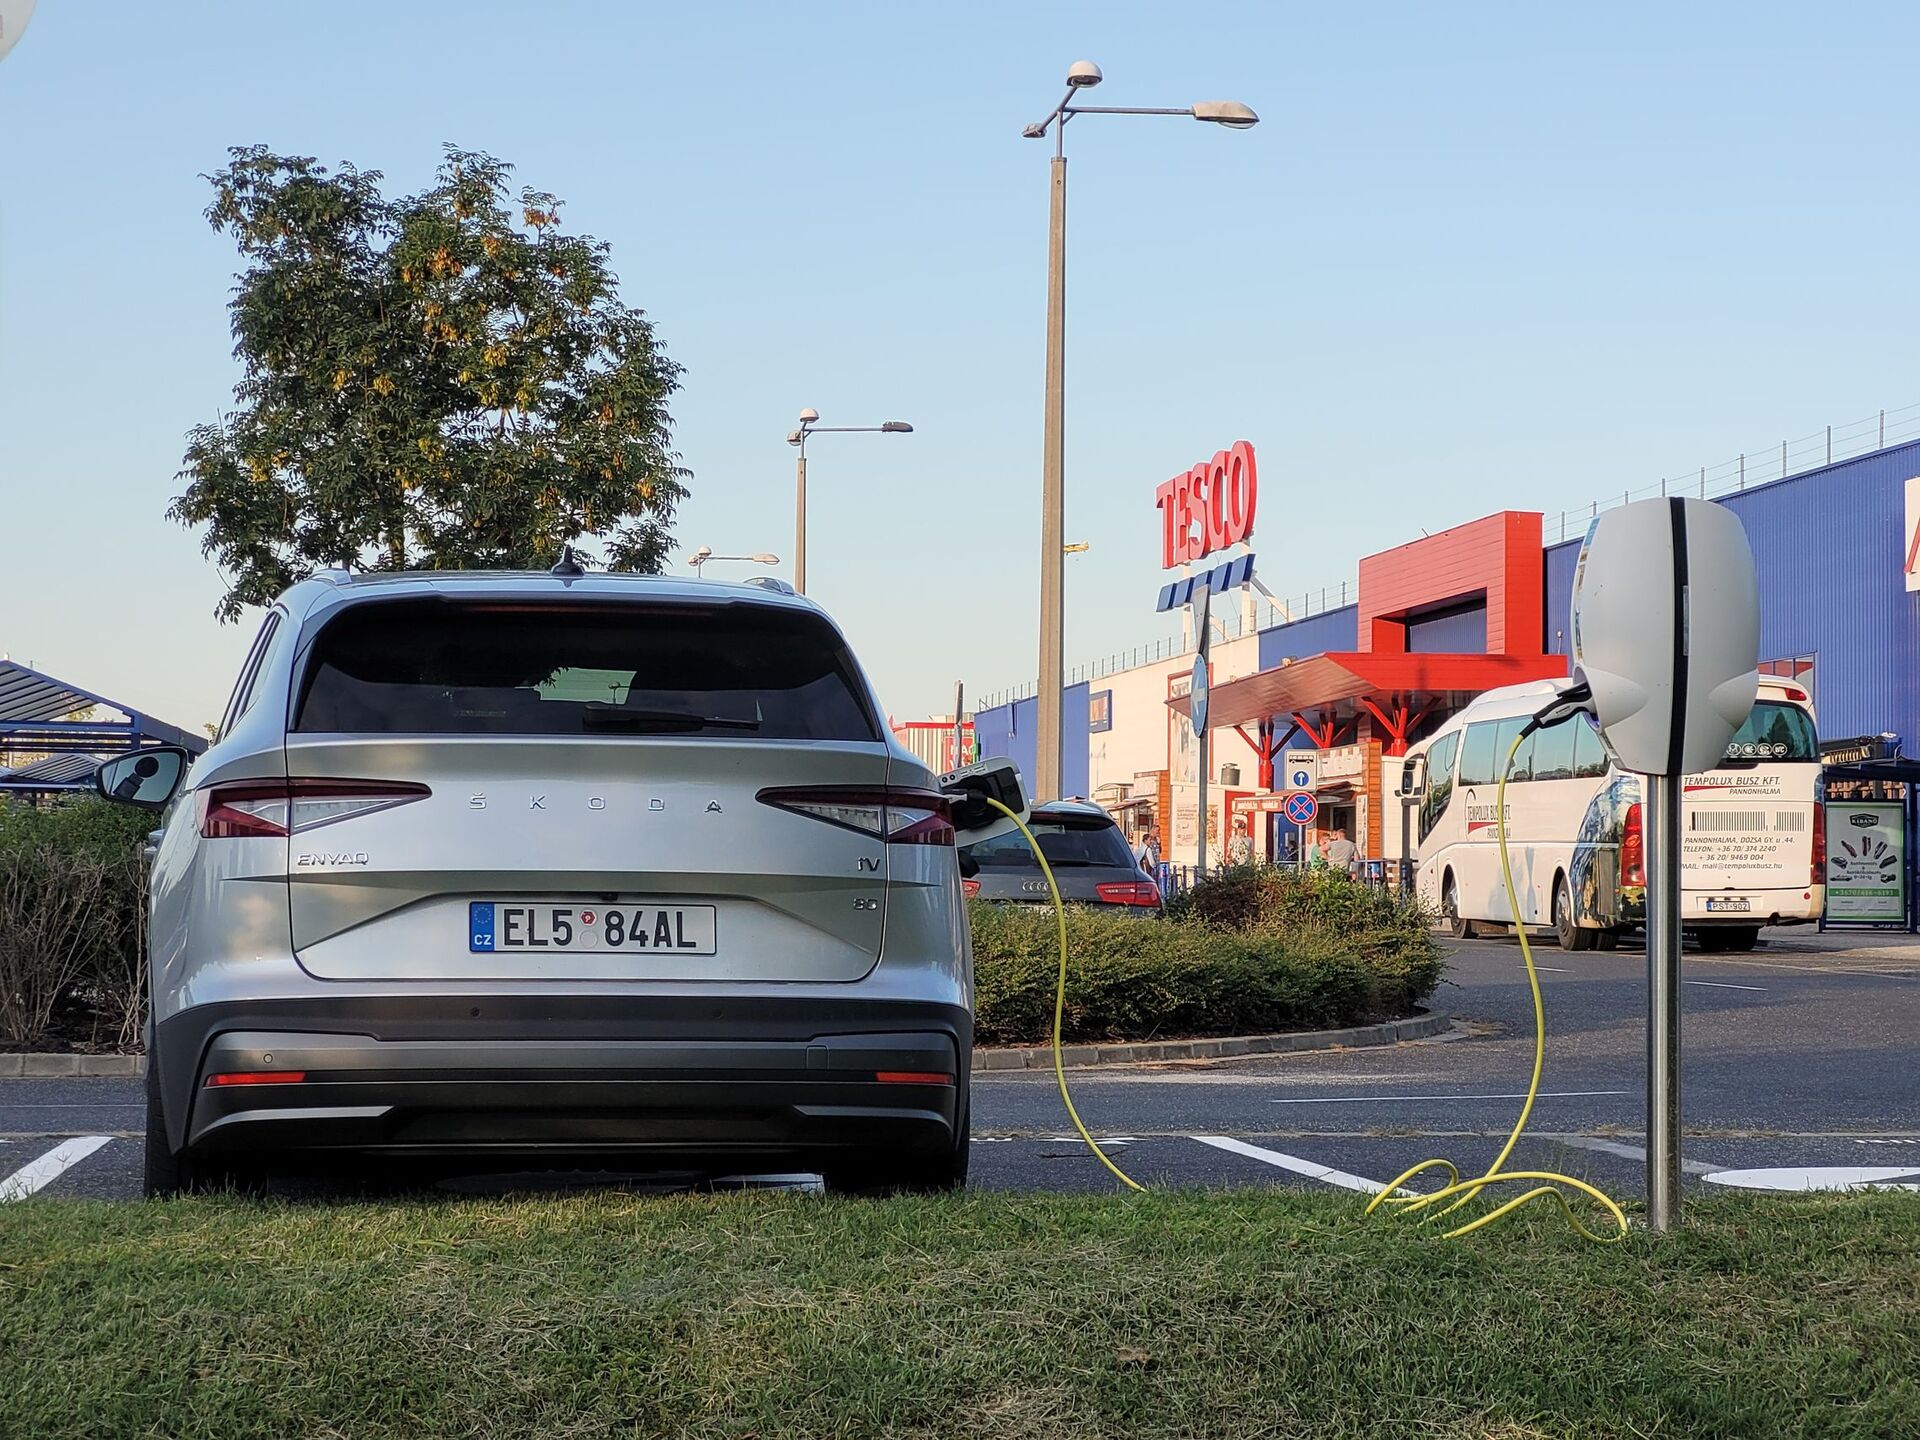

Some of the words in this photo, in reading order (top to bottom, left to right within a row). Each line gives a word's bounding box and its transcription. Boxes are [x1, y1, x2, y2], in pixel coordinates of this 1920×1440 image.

[1156, 440, 1257, 569] TESCO
[1684, 777, 1732, 785] TEMPOLUX
[1736, 777, 1760, 785] BUSZ
[1762, 776, 1780, 785] KFT.
[469, 792, 722, 814] ŠKODA
[297, 852, 369, 866] ENYAQ
[1712, 901, 1747, 910] PST-902
[503, 909, 573, 946] EL5
[605, 910, 696, 947] 84AL
[474, 934, 491, 945] CZ
